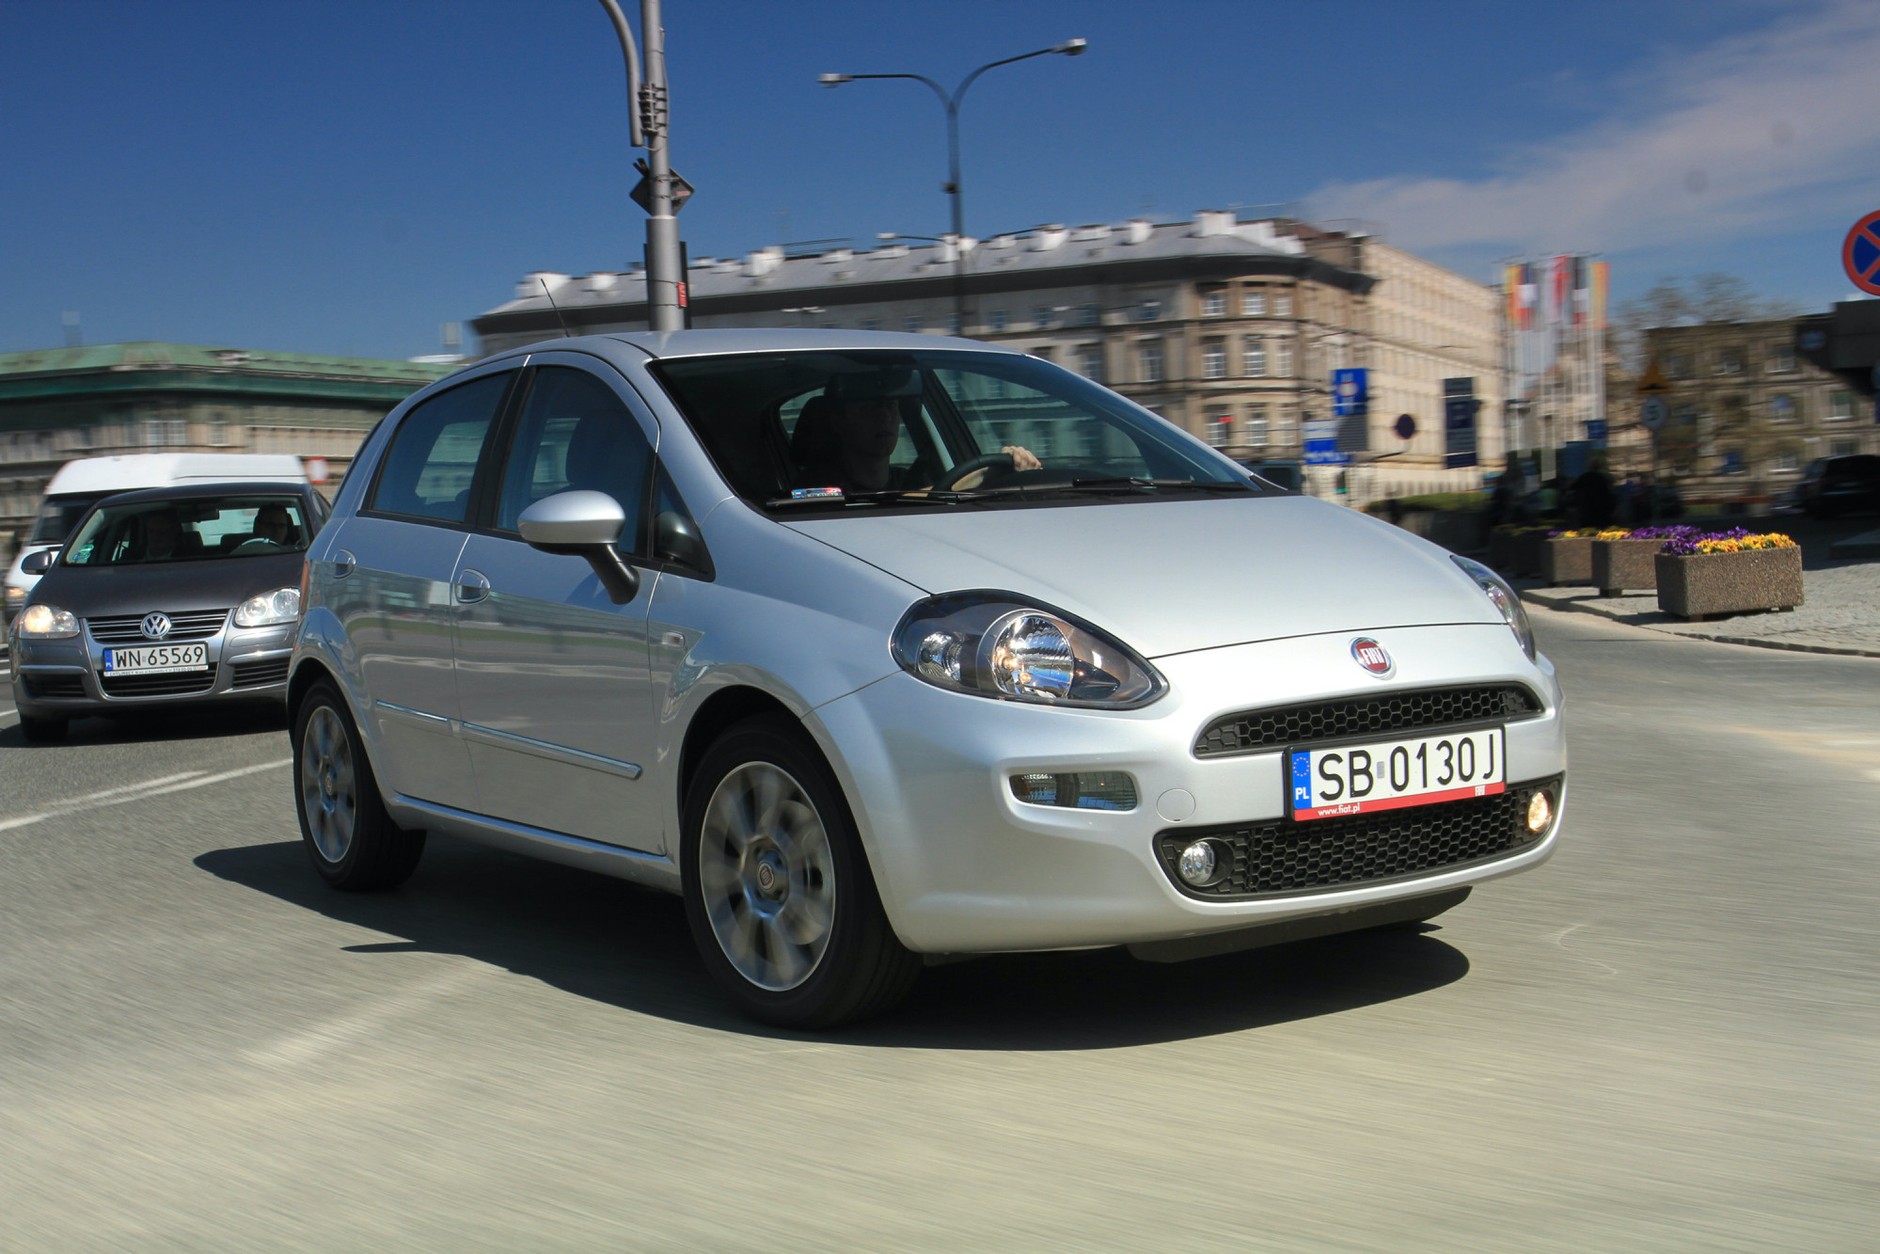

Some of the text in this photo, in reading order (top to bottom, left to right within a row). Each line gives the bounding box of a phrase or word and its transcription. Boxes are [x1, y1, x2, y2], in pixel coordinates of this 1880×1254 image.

[115, 647, 203, 667] WN 65569
[1360, 647, 1385, 665] FIAT
[1318, 733, 1495, 801] SB 0130J
[1295, 786, 1310, 801] PL
[1317, 801, 1360, 816] www.fiat.pl
